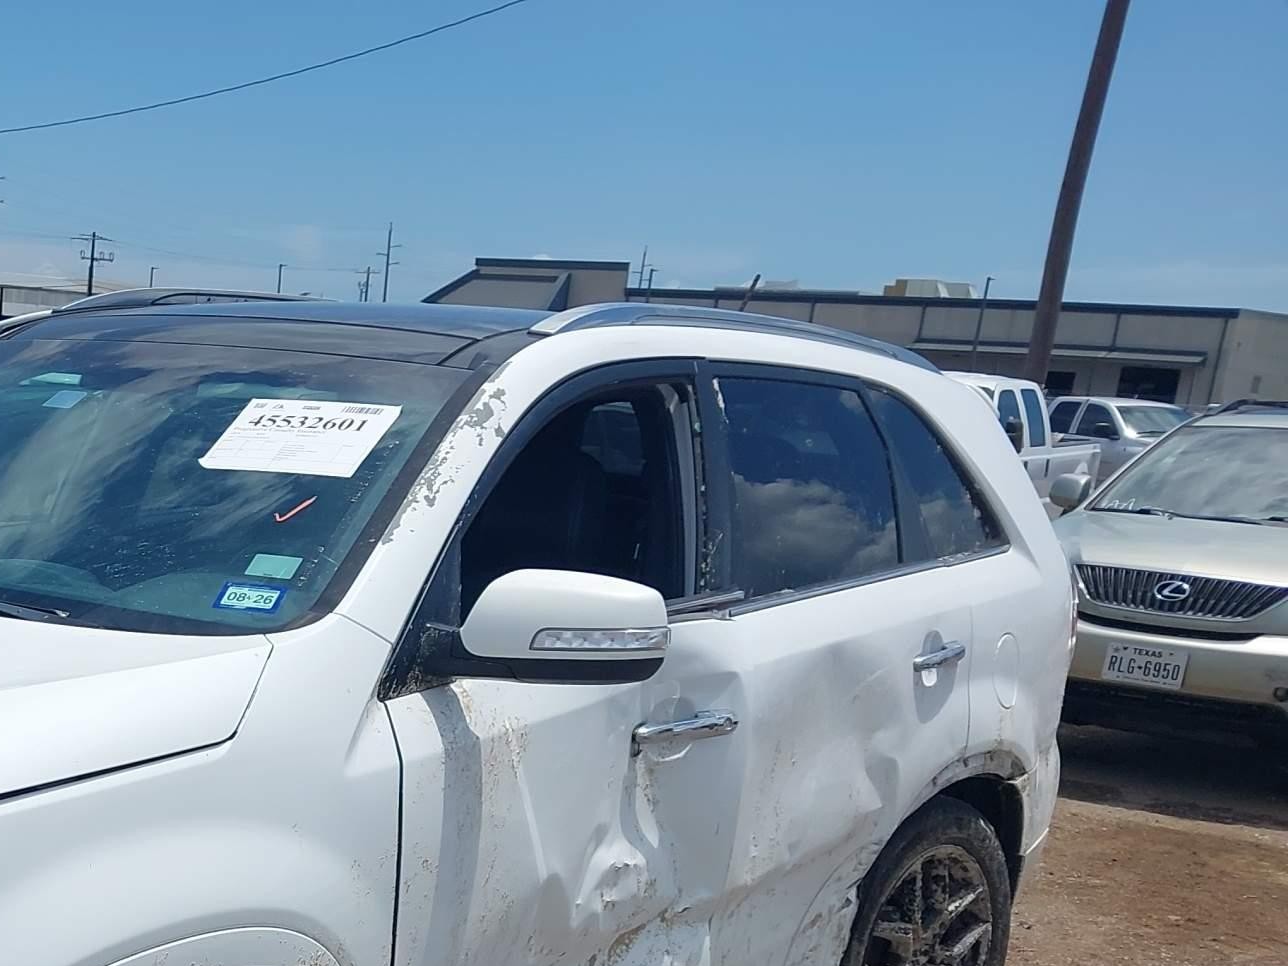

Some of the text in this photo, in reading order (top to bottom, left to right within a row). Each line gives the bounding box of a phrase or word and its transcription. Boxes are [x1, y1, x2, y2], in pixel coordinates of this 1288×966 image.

[248, 414, 369, 432] 45532601
[226, 591, 274, 605] 08 26
[1133, 647, 1163, 659] TEXAS
